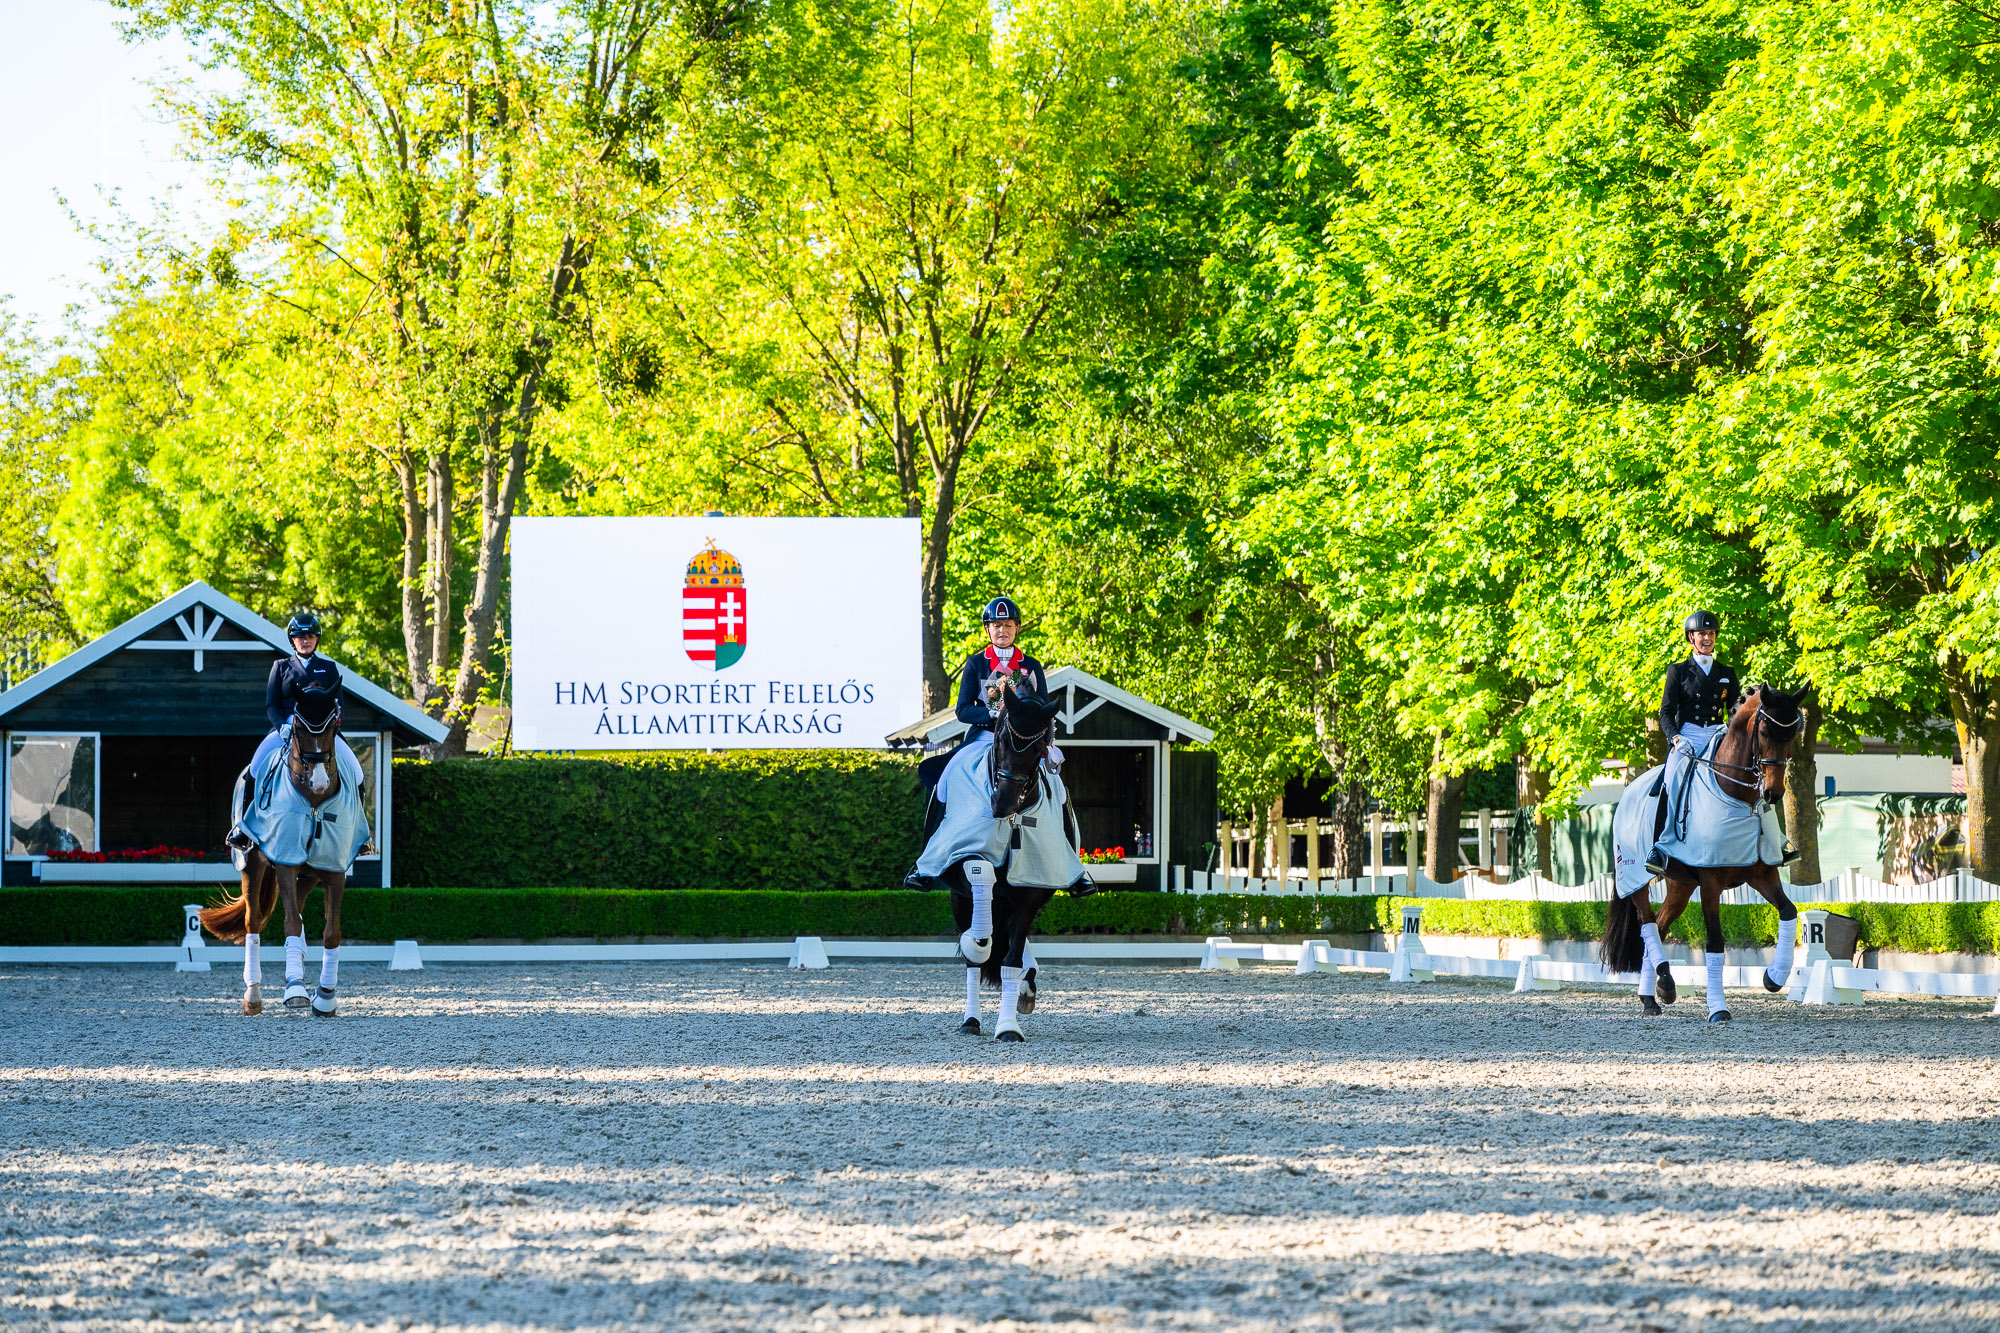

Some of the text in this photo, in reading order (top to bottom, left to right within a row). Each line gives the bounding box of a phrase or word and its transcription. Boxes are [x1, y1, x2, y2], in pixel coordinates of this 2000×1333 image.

[555, 682, 608, 704] HM
[189, 915, 199, 931] C
[1406, 917, 1420, 934] M
[1810, 923, 1824, 944] R
